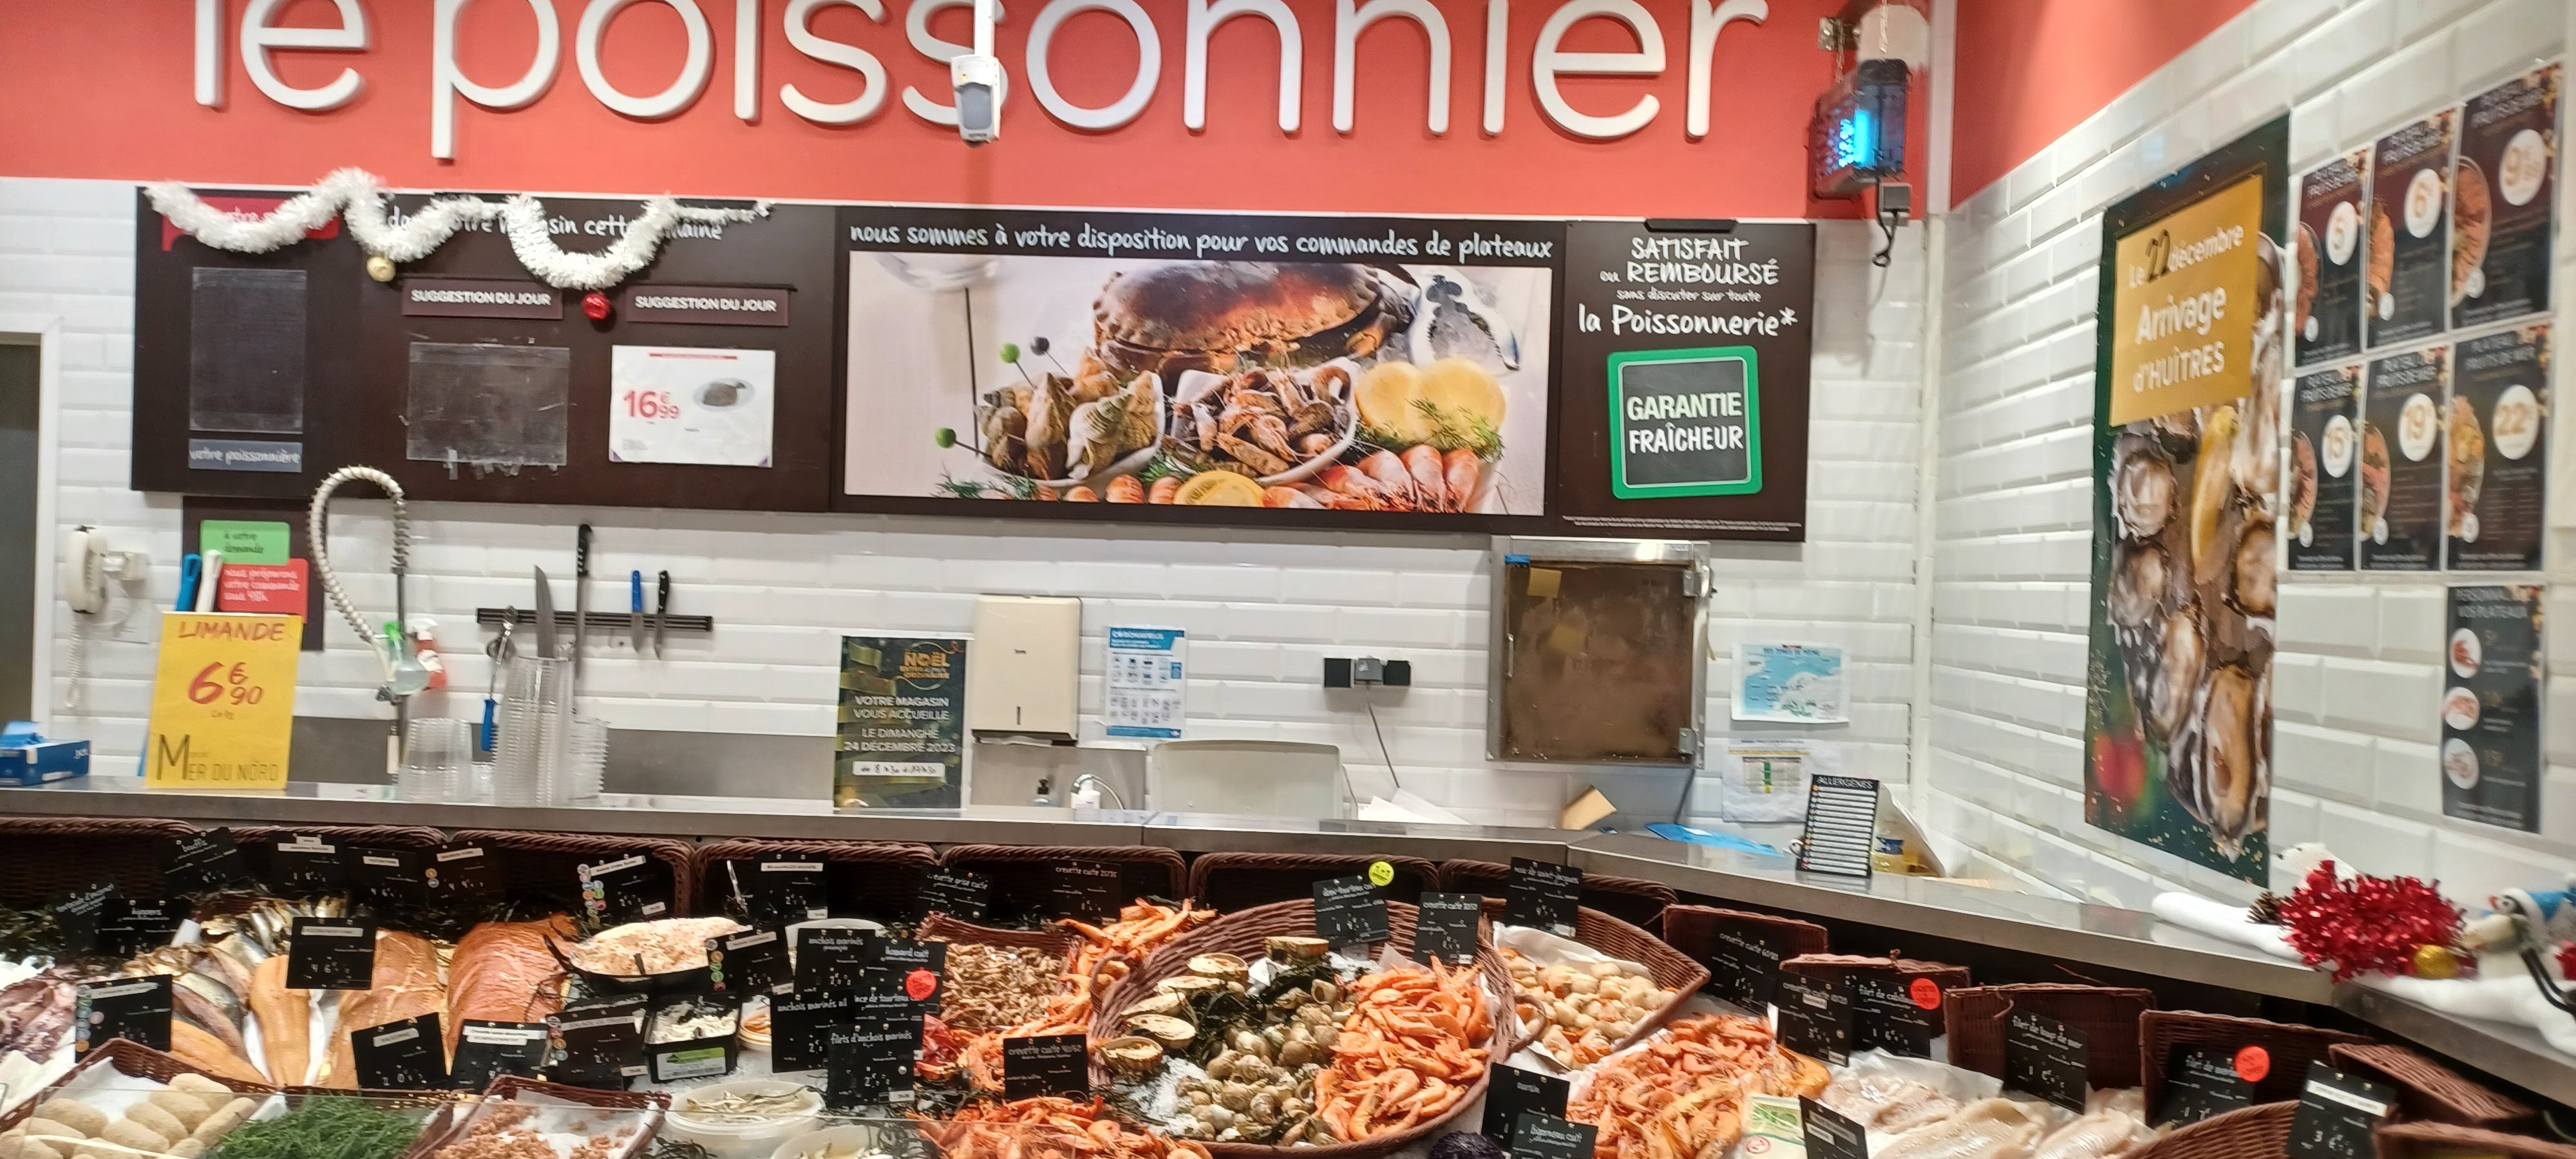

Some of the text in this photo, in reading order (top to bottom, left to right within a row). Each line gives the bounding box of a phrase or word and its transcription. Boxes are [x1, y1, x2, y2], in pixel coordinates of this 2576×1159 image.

[195, 0, 1768, 159] le poissonnier
[850, 222, 1553, 263] nous sommes à votre disposition pour vos commandes de plateaux
[1631, 237, 1749, 260] SATISFAIT
[2168, 223, 2244, 273] décembre
[1600, 258, 1780, 285] ou REMBOURSÉ
[411, 289, 552, 306] SUGGESTION DU JOUR
[635, 296, 777, 312] SUGGESTION DU JOUR
[1616, 287, 1761, 303] sans discuter sur toute
[1578, 303, 1602, 334] la
[2134, 286, 2227, 345] Arrivage
[2132, 340, 2225, 393] d'HUÎTRES
[1627, 391, 1743, 421] GARANTIE
[1628, 422, 1744, 453] FRAÎCHEUR
[178, 622, 285, 642] LIMANDE
[855, 695, 949, 707] VOTRE MAGASIN
[853, 708, 950, 721] VOUS ACCUEILLE
[862, 728, 940, 739] LE DIMANCHE
[844, 741, 859, 751] 24
[927, 742, 956, 753] 2023
